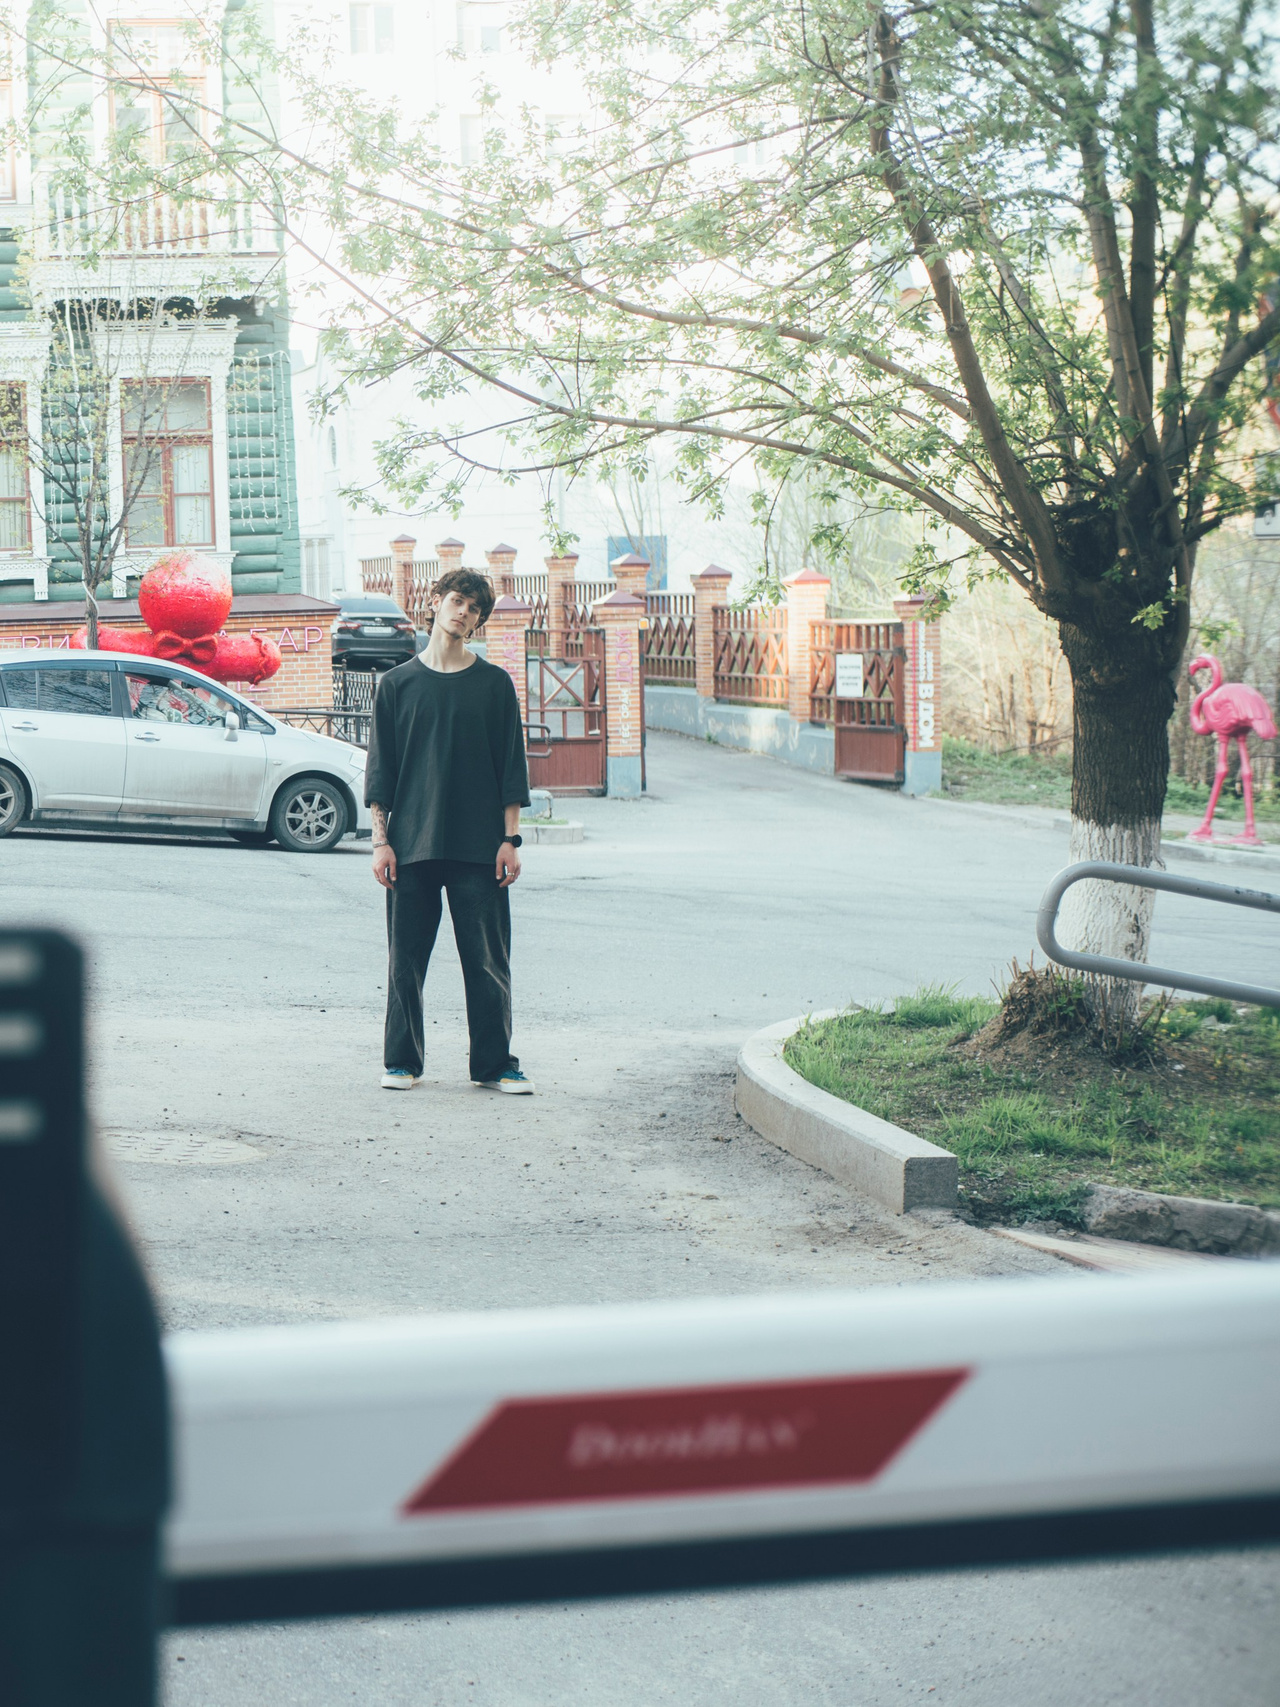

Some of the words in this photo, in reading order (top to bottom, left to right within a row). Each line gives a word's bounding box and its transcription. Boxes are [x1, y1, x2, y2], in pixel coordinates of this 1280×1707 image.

[250, 626, 324, 652] АР
[615, 629, 634, 684] ДОМ
[620, 688, 631, 744] ЕСОРАН
[918, 700, 934, 748] ДОМ
